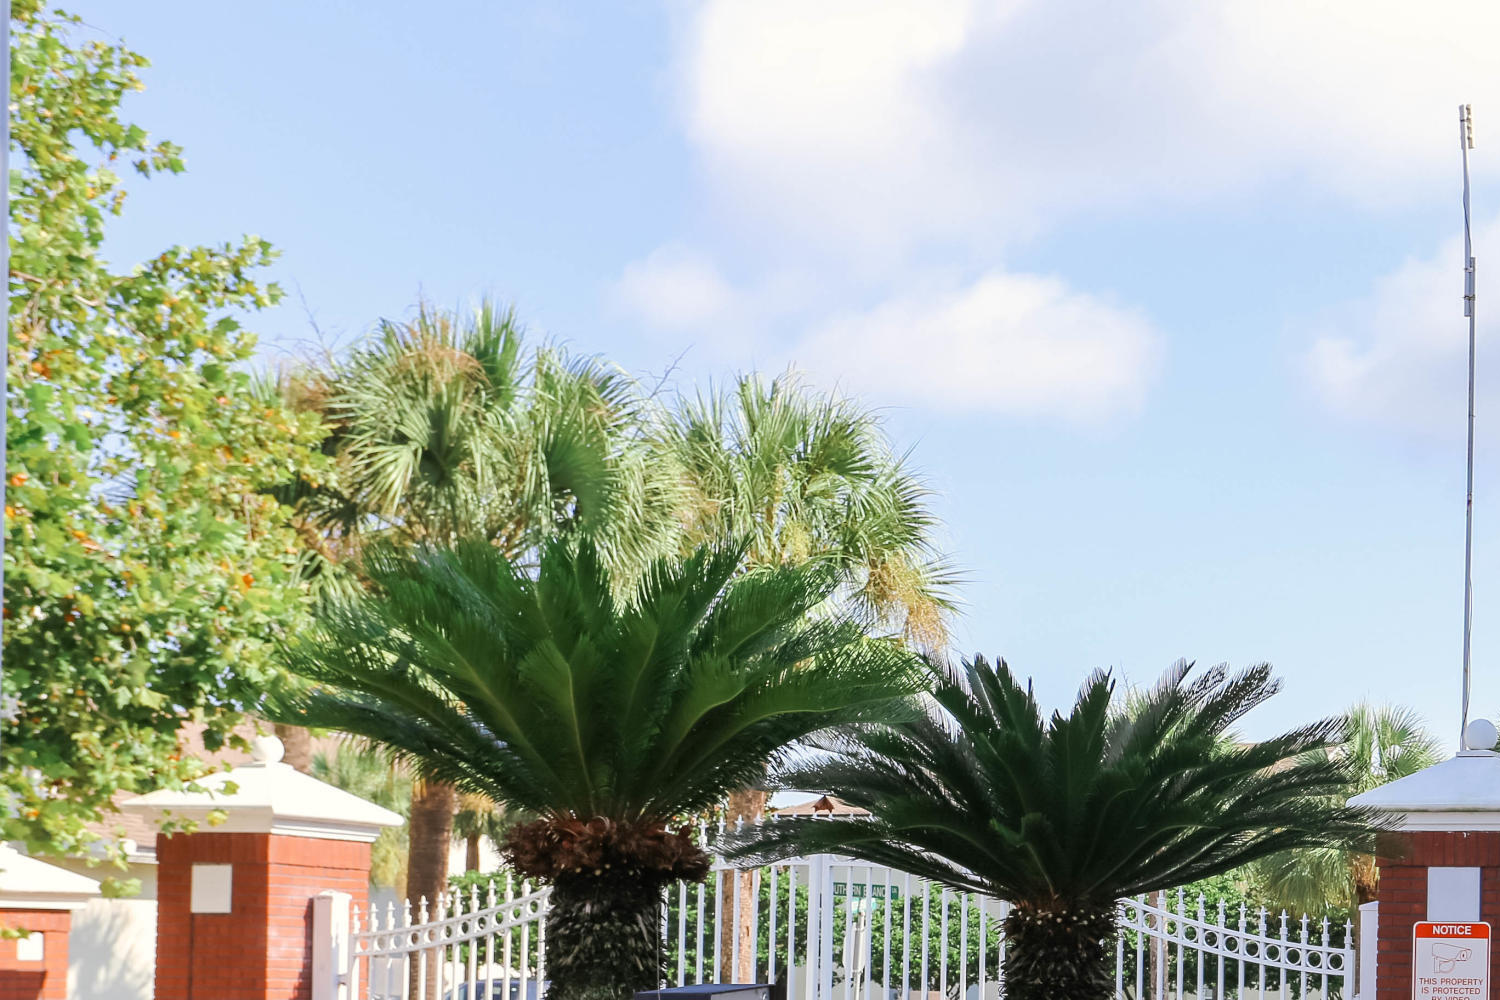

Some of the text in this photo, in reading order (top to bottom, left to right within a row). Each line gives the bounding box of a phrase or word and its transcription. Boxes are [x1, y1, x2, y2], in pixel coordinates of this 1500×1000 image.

[1432, 925, 1472, 935] NOTICE
[1440, 978, 1483, 986] PROPERTY
[1432, 987, 1481, 995] PROTECTED
